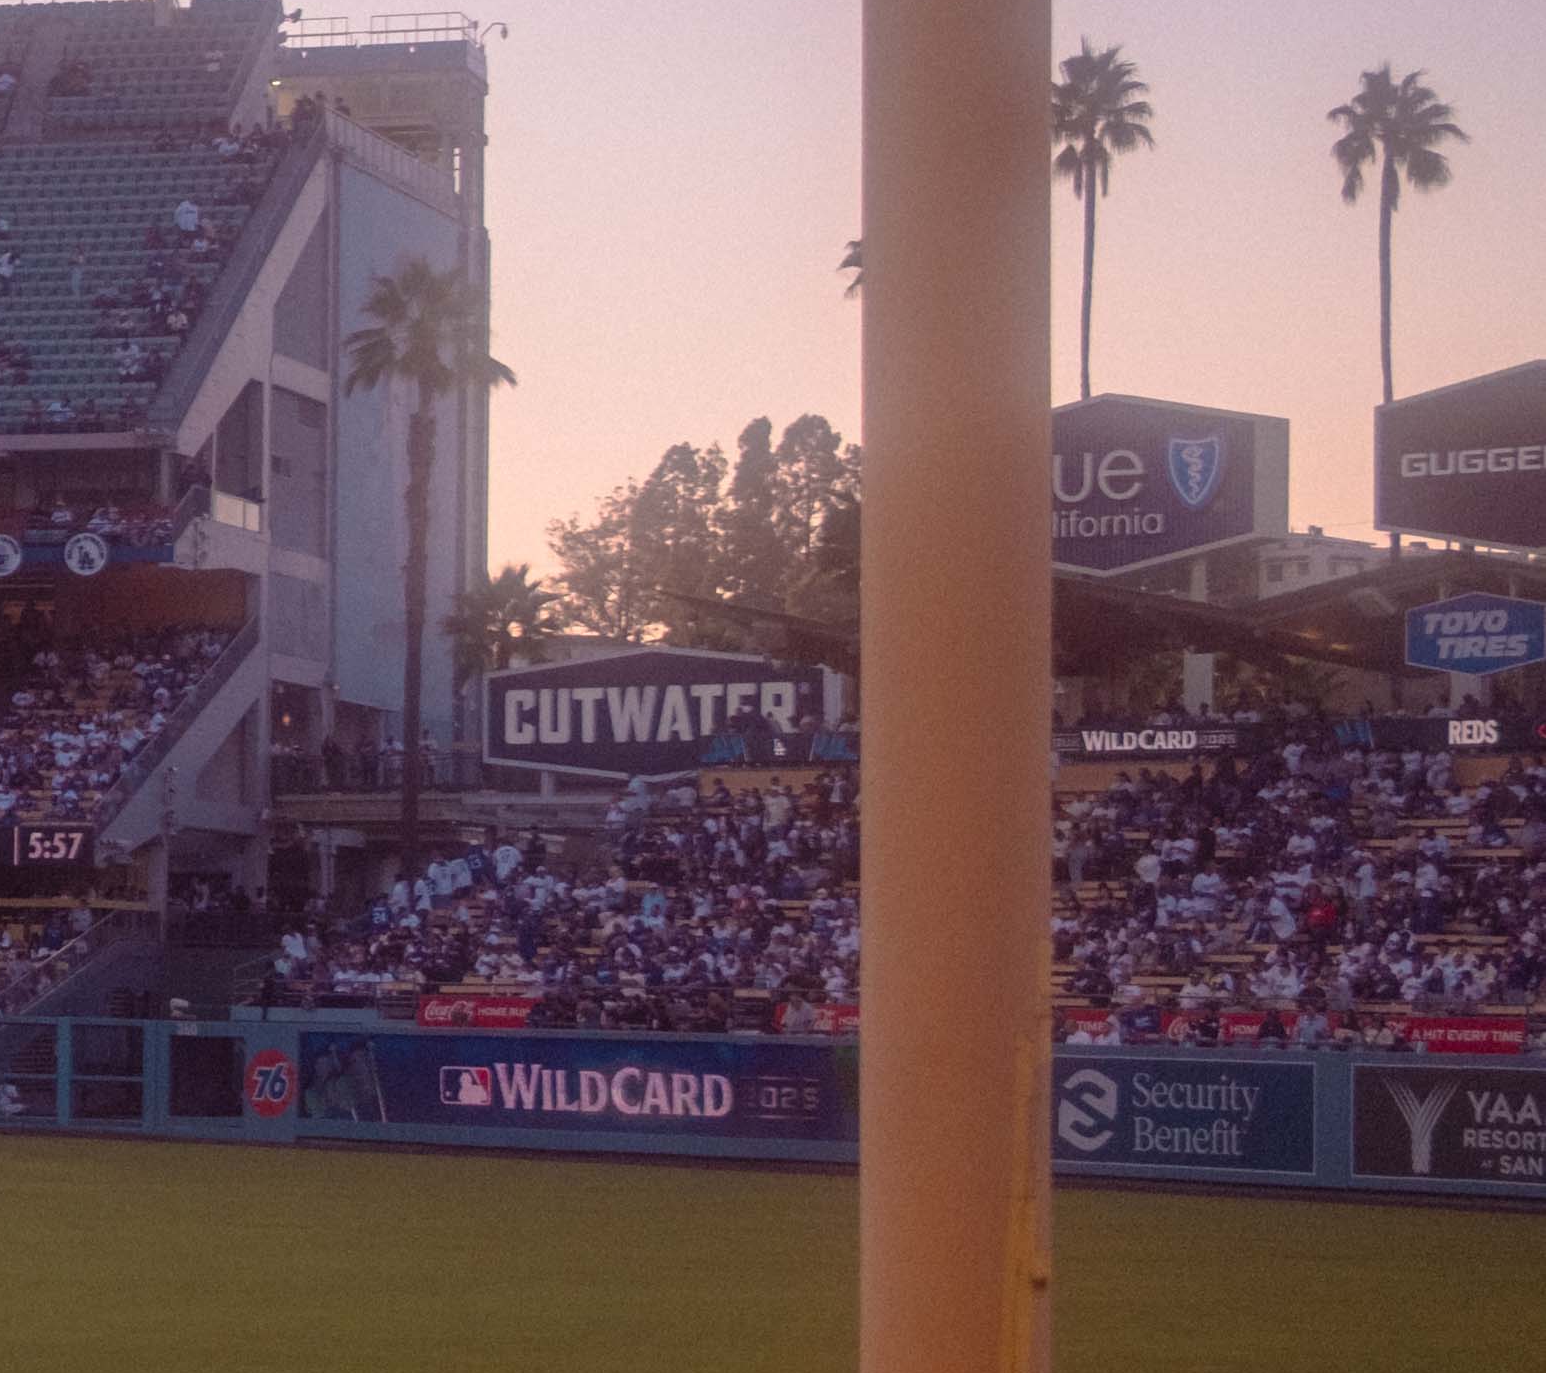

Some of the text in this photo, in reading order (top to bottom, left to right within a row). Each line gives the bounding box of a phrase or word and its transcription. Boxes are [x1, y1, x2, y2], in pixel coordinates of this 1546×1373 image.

[1400, 445, 1546, 478] GUGGE
[1424, 609, 1509, 636] TOYO
[1437, 634, 1530, 660] TIRES
[503, 682, 801, 746] CUTWATER
[1448, 719, 1500, 745] REDS
[28, 831, 84, 860] 5:57
[1410, 1028, 1422, 1039] A
[1425, 1028, 1446, 1041] HIT
[1447, 1029, 1486, 1042] EVERY
[1487, 1029, 1524, 1043] TIME
[250, 1061, 289, 1103] 76
[1130, 1071, 1262, 1123] Security
[1465, 1089, 1543, 1127] YAA
[1131, 1115, 1246, 1157] Benefit
[1499, 1154, 1544, 1178] SAN
